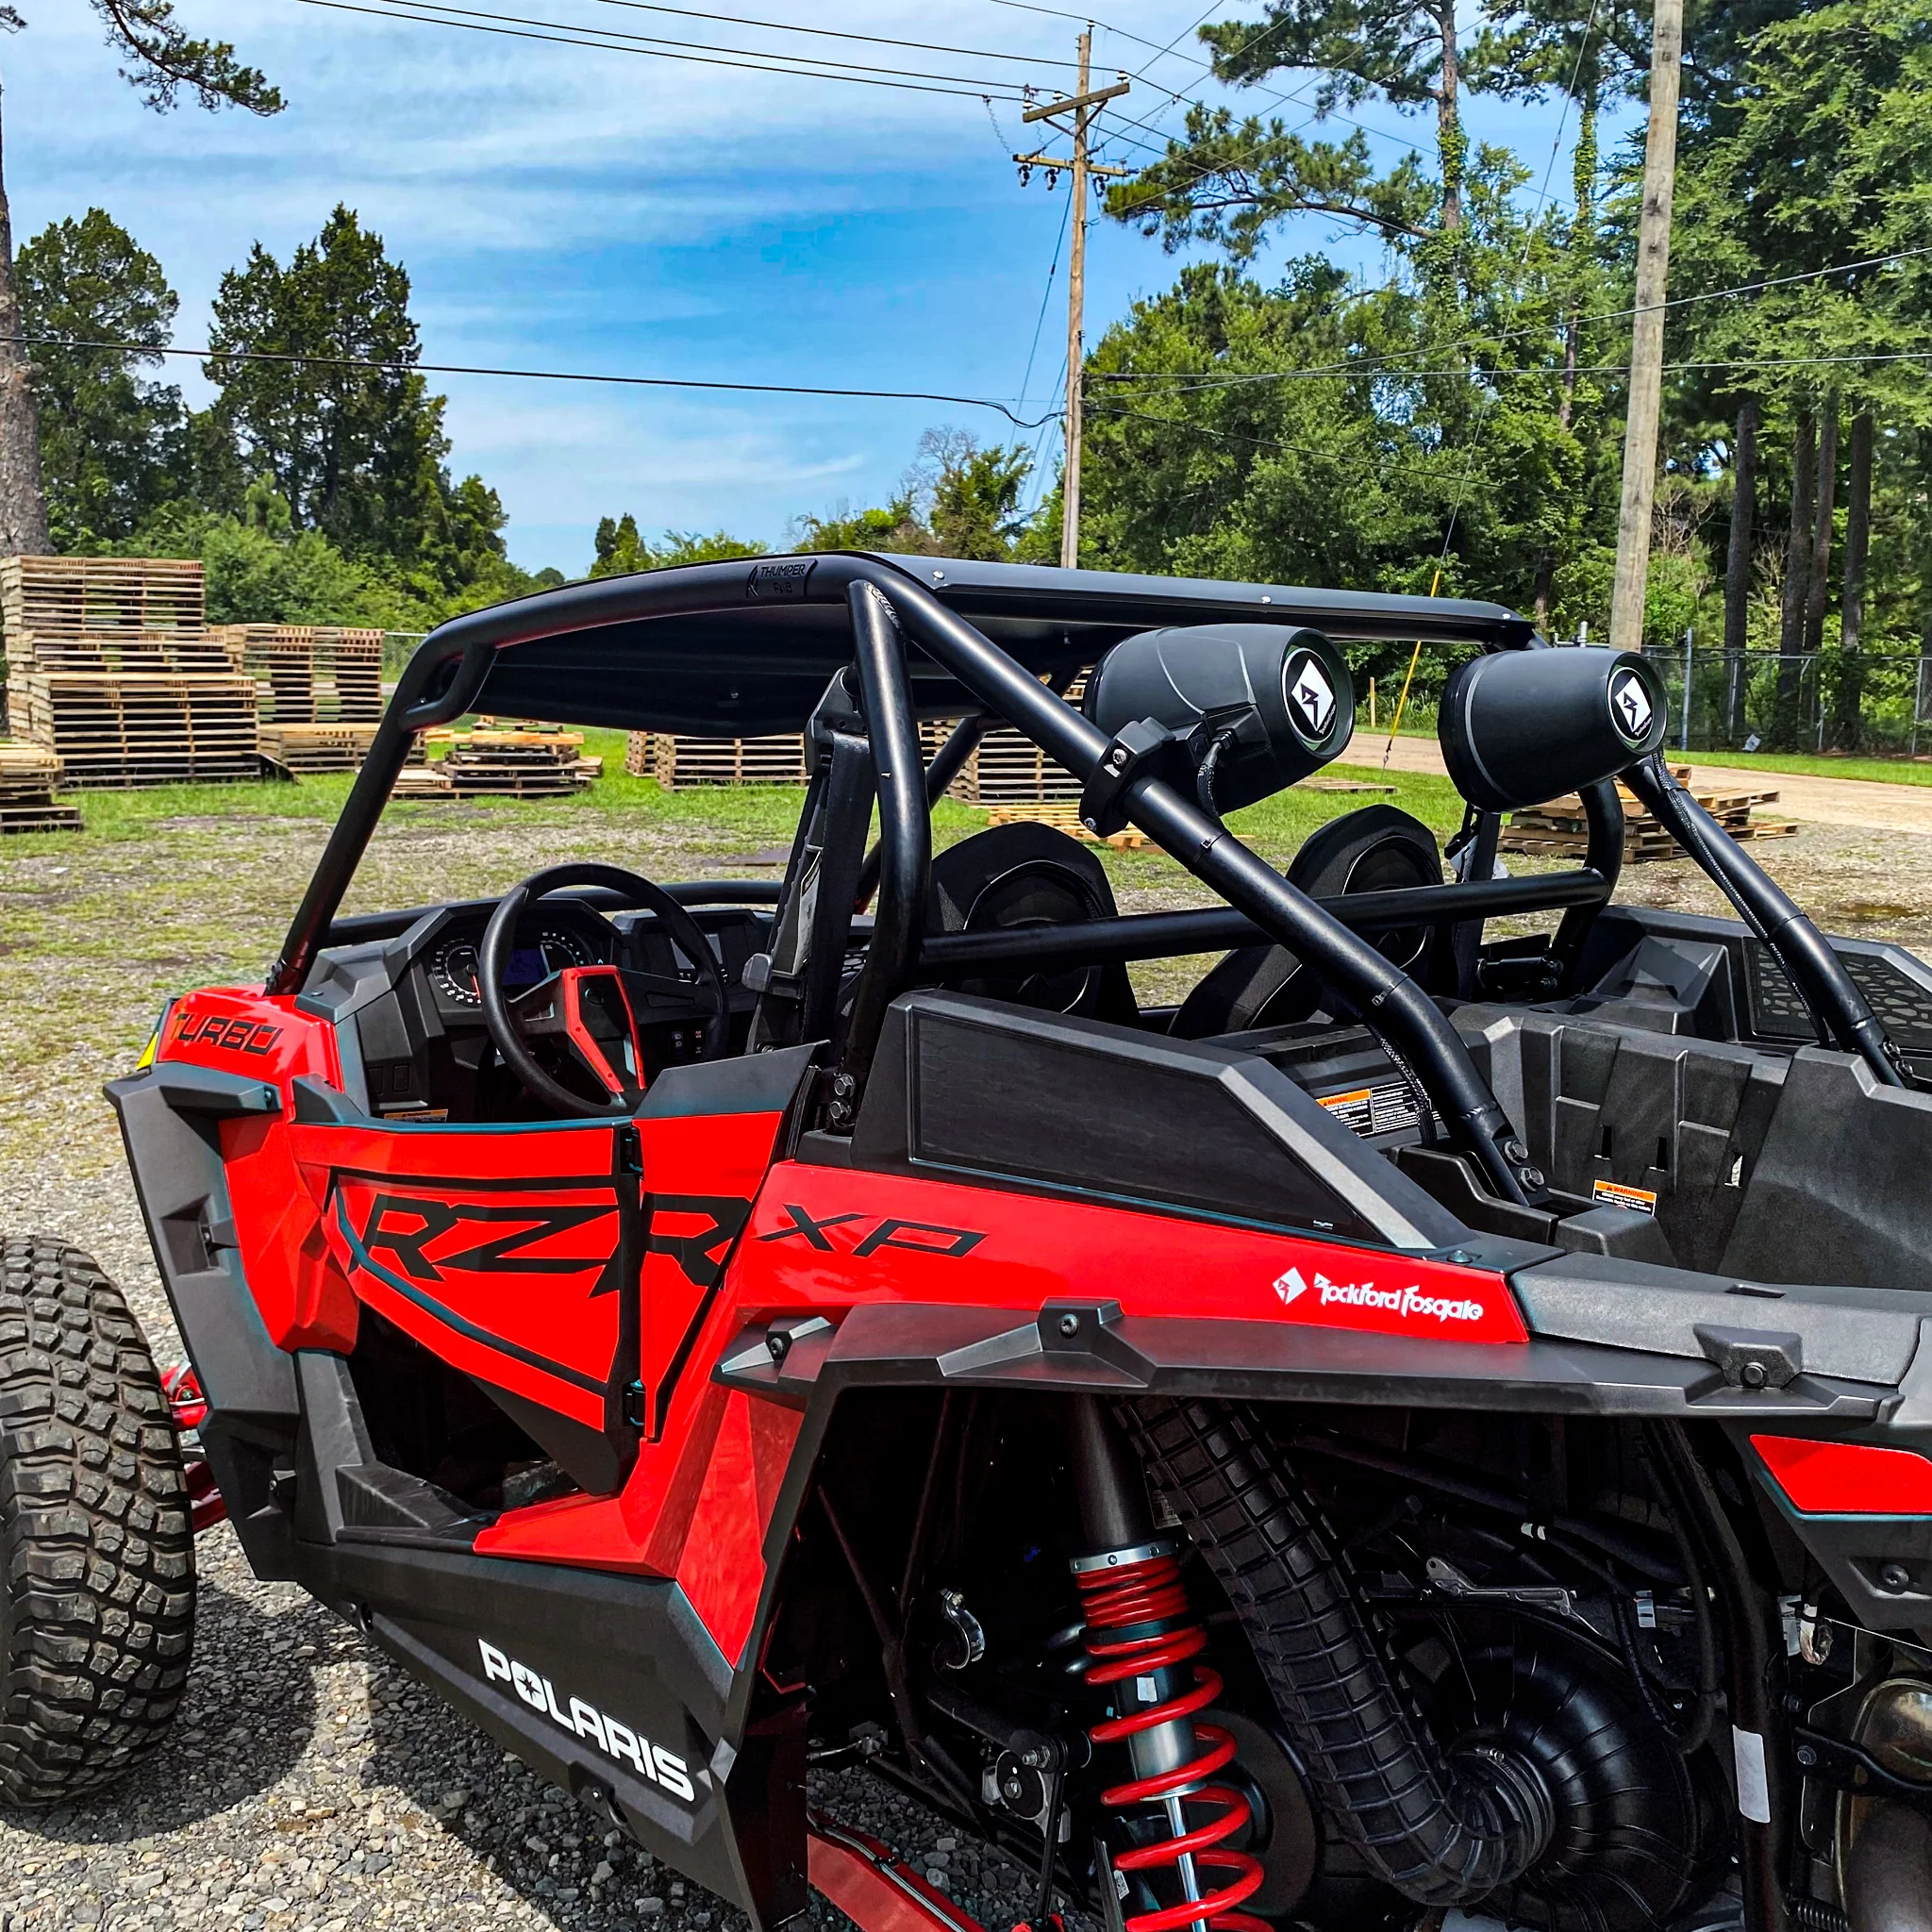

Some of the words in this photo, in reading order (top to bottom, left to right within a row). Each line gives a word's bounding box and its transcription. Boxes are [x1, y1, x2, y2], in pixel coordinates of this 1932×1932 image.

[760, 564, 807, 577] THUMPER
[773, 581, 793, 594] FAB
[170, 1012, 284, 1056] TURBO
[1614, 1185, 1644, 1198] WARNING
[349, 1192, 753, 1299] RZR
[758, 1204, 988, 1257] XP
[1313, 1272, 1402, 1309] Rockford
[1401, 1284, 1484, 1323] Fosgate
[478, 1638, 695, 1802] POLARIS
